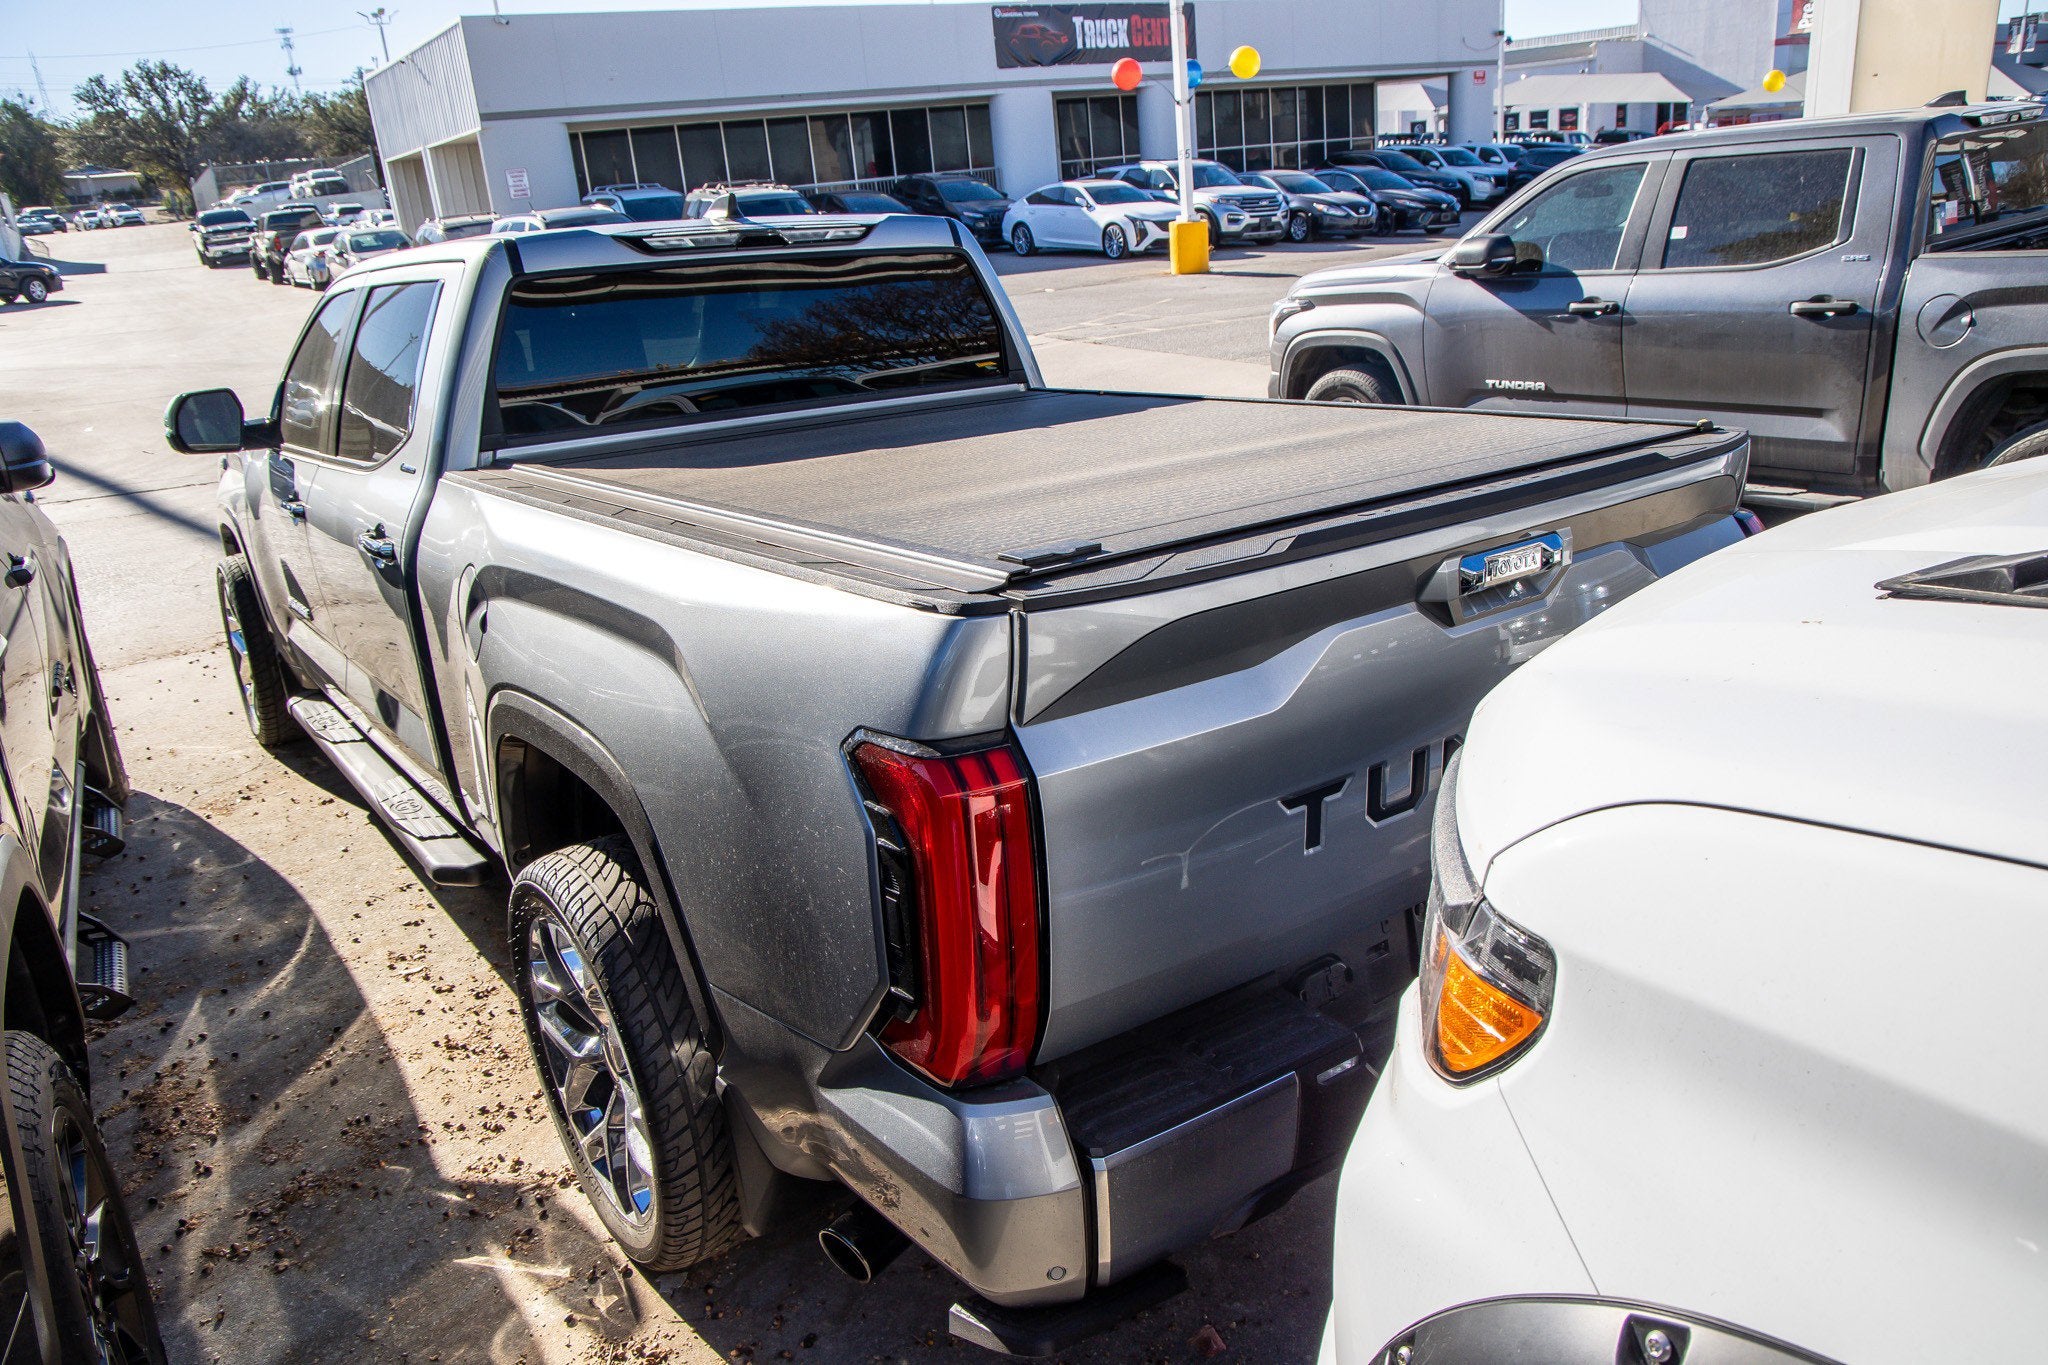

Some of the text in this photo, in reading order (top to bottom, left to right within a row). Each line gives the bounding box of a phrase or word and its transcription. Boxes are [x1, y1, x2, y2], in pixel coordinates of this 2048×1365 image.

[1072, 14, 1188, 49] TRUCK CENT
[1485, 379, 1546, 391] TUNDRA
[1488, 552, 1538, 578] TOYOTA
